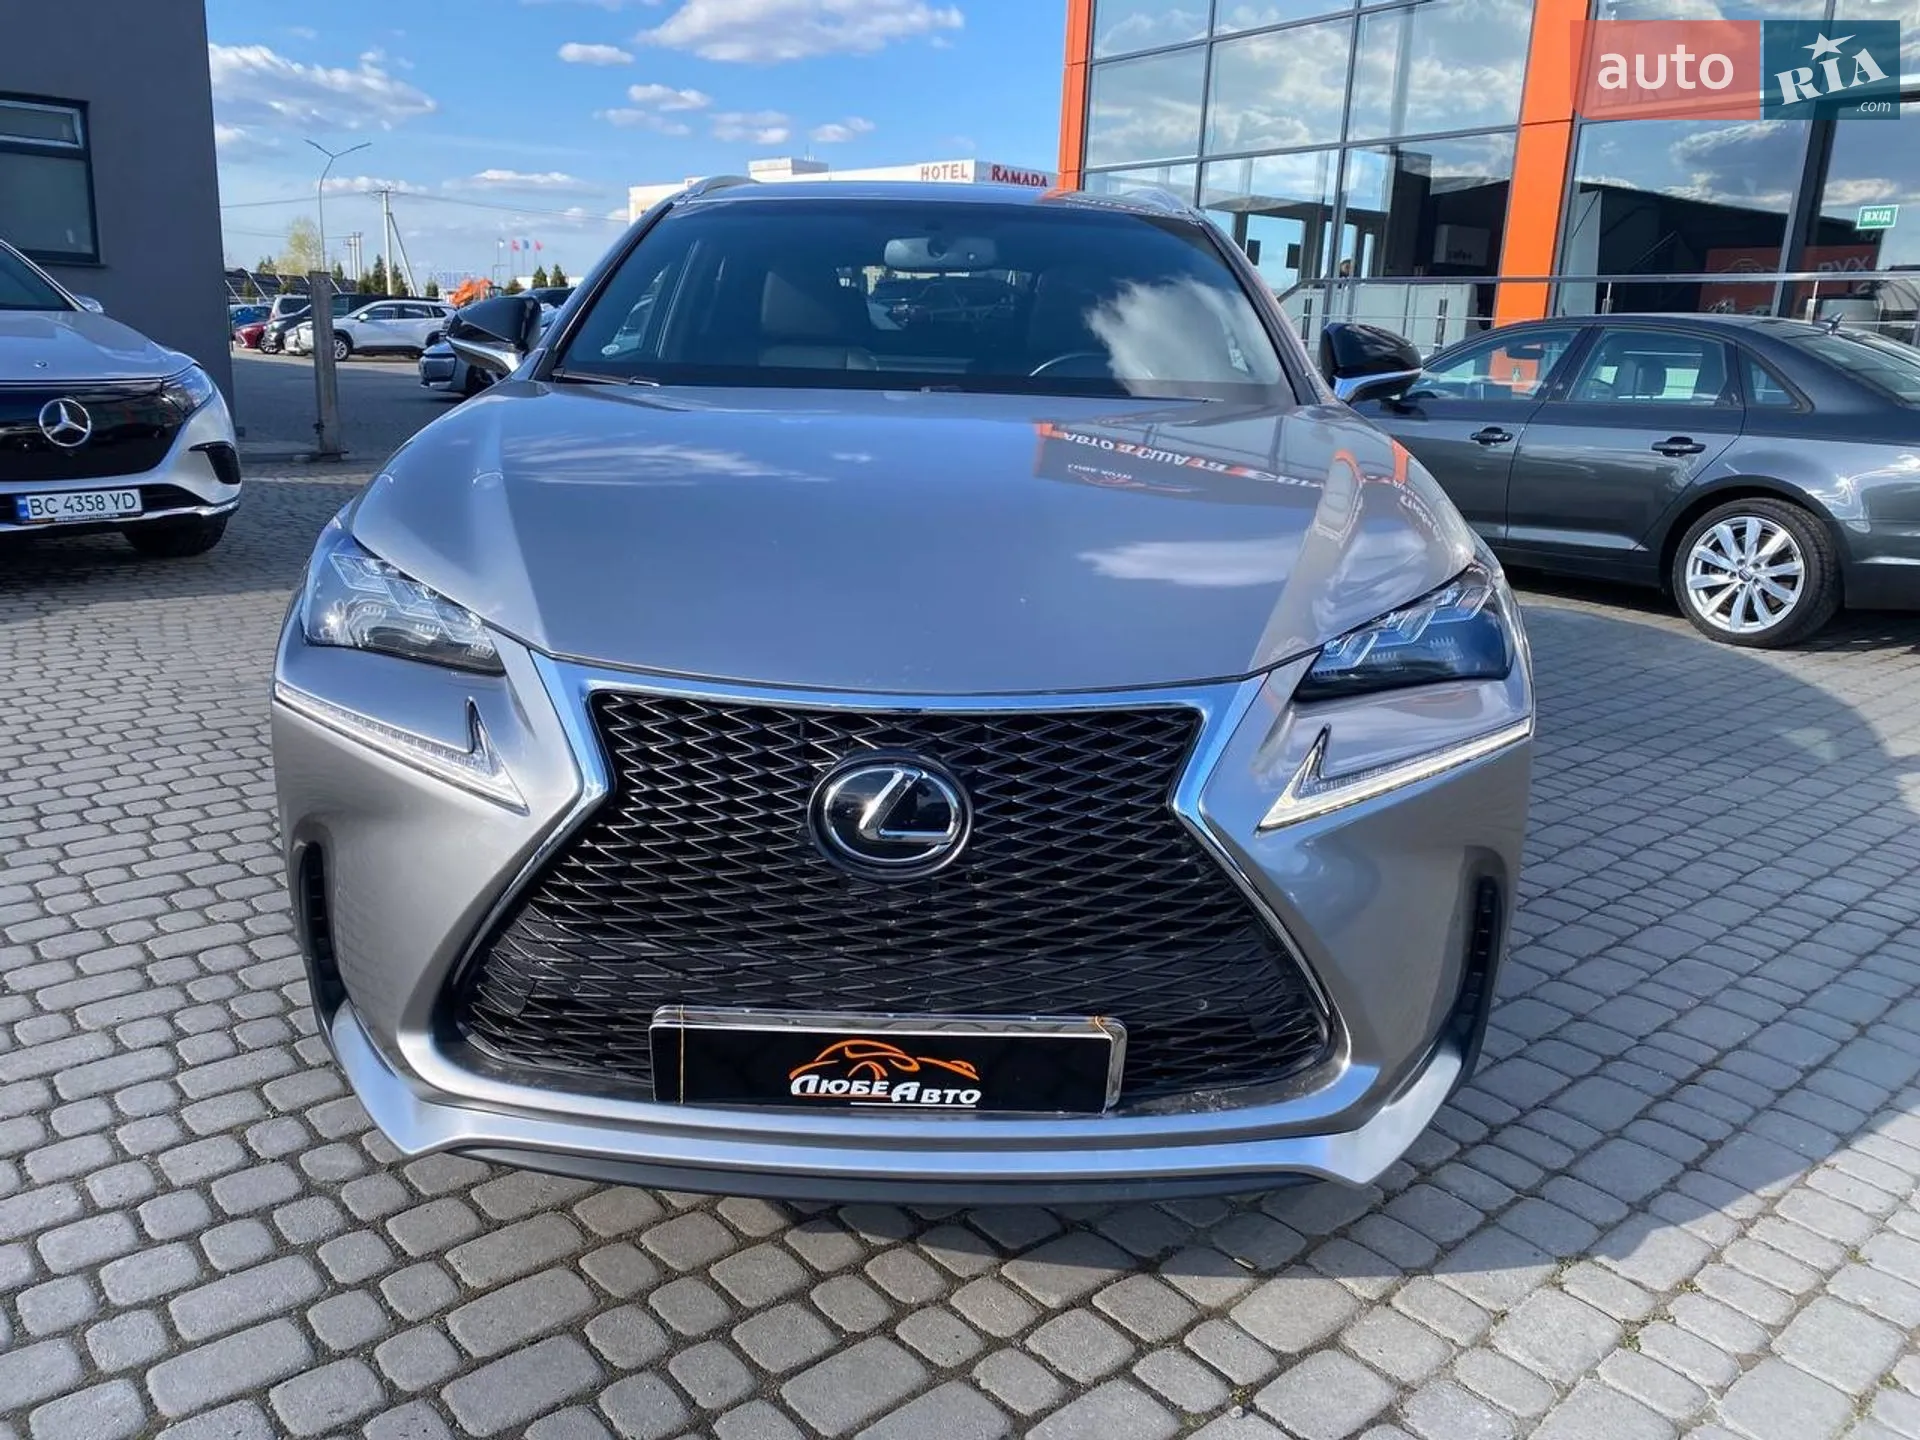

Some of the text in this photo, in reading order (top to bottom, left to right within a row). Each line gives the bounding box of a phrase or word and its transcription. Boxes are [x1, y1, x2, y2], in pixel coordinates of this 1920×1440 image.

[920, 162, 969, 182] HOTEL
[991, 163, 1048, 188] RAMADA
[30, 492, 137, 516] BC 4358 YD
[790, 1074, 982, 1105] ЛЮБЕ АВТО
